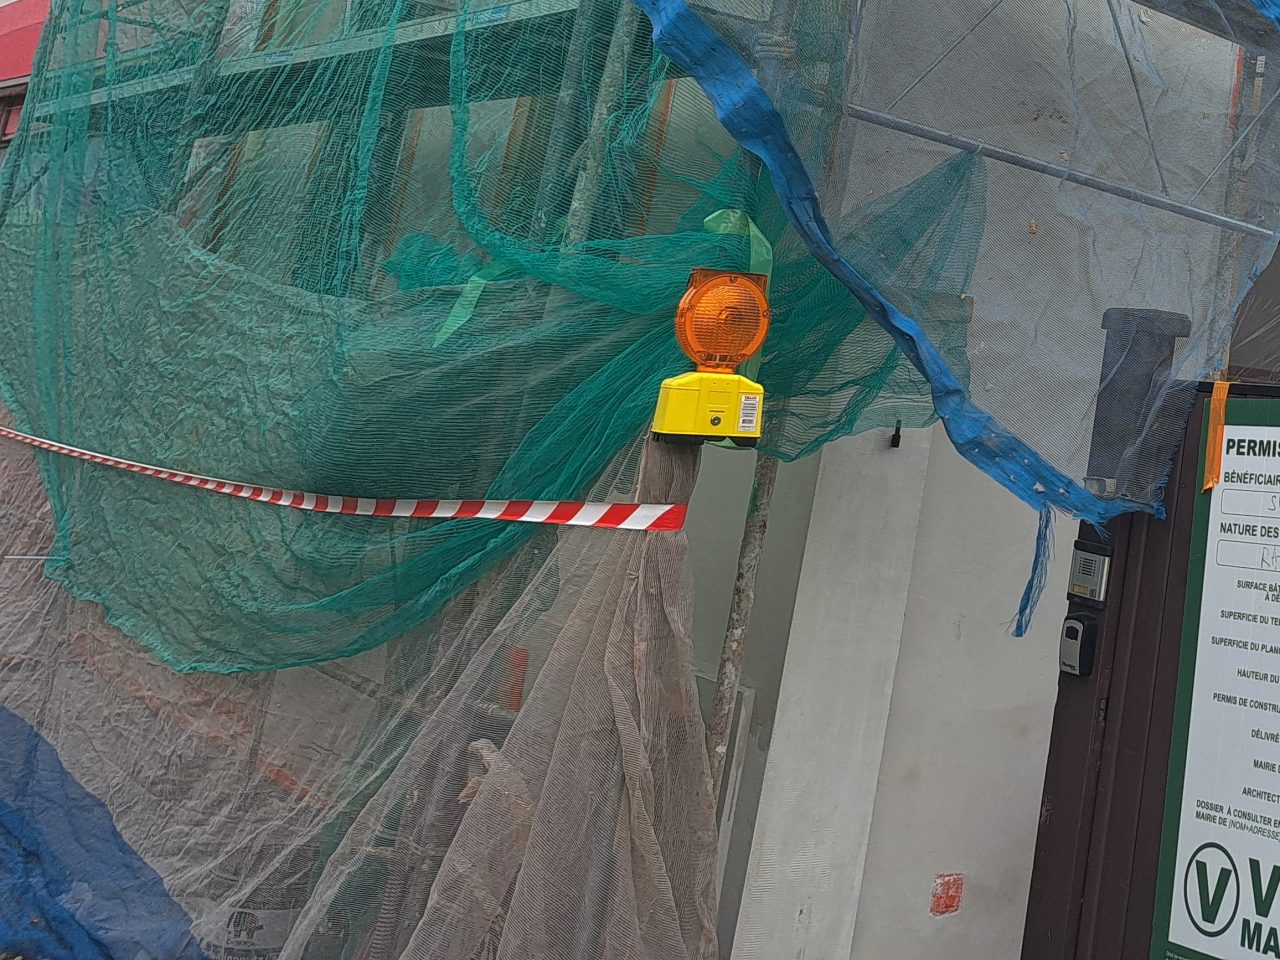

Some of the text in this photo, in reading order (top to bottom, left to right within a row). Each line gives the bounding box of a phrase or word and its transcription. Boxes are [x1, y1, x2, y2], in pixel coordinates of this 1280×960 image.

[1220, 522, 1258, 536] NATURE
[1260, 526, 1280, 538] DES
[1237, 580, 1267, 592] SURFACE
[1220, 610, 1258, 623] SUPERFICIE
[1259, 615, 1269, 624] DU
[1211, 636, 1249, 650] SUPERFICIE
[1250, 642, 1260, 651] DU
[1237, 668, 1269, 682] HAUTEUR
[1269, 674, 1280, 683] DU
[1213, 693, 1237, 705] PERMIS
[1238, 698, 1248, 707] DE
[1251, 728, 1280, 743] DÉLIVRÉ
[1253, 759, 1276, 773] MAIRIE
[1195, 810, 1217, 824] MAIRIE
[1218, 816, 1228, 826] DE
[1196, 799, 1224, 814] DOSSIER
[1233, 808, 1272, 826] CONSULTER
